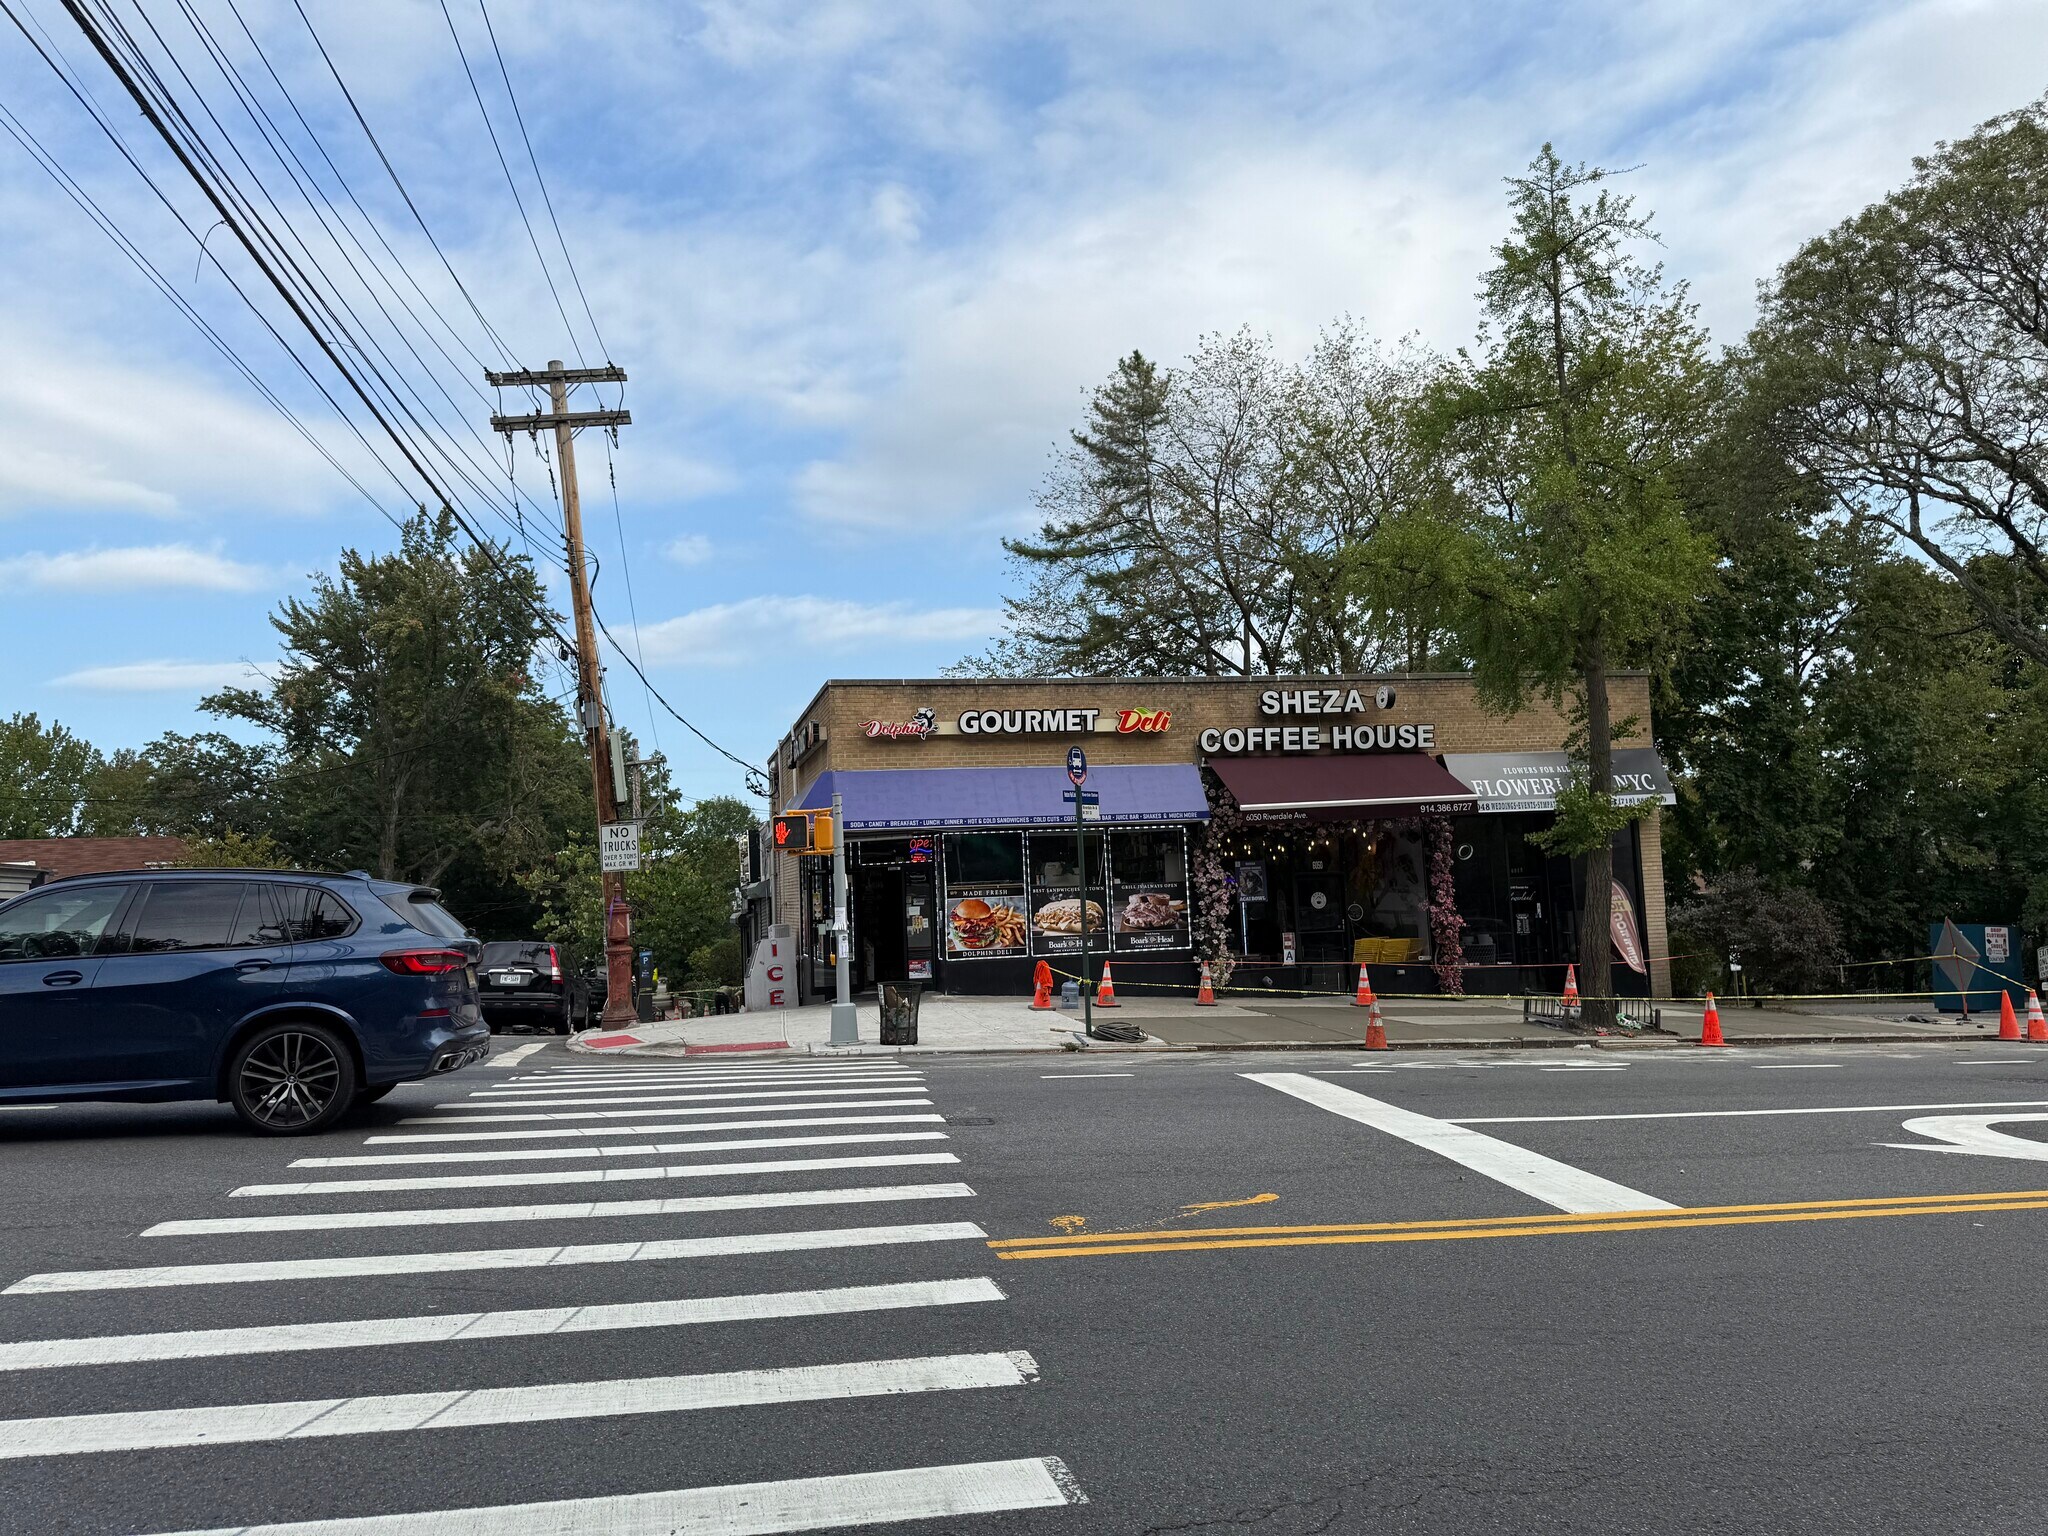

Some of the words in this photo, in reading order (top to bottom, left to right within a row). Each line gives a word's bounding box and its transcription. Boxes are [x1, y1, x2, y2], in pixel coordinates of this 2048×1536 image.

[1261, 689, 1366, 715] SHEZA
[958, 709, 1100, 735] GOURMET
[1116, 708, 1172, 734] Deli
[1200, 727, 1321, 753] COFFEE
[1332, 724, 1436, 751] HOUSE
[1503, 767, 1538, 775] FLOWERS
[1540, 766, 1554, 774] FOR
[1556, 765, 1570, 773] ALL
[1471, 777, 1577, 797] FLOWERL
[1613, 773, 1656, 791] NYC
[1420, 803, 1472, 813] 914.386.6727
[1263, 812, 1292, 820] Riverdale
[610, 827, 629, 839] NO
[603, 839, 637, 852] TRUCKS
[1048, 940, 1067, 948] Boar's
[1076, 939, 1094, 948] Hd
[1130, 936, 1149, 944] Boar's
[1158, 934, 1174, 943] Head
[1286, 951, 1293, 960] A
[767, 940, 784, 1005] ICE
